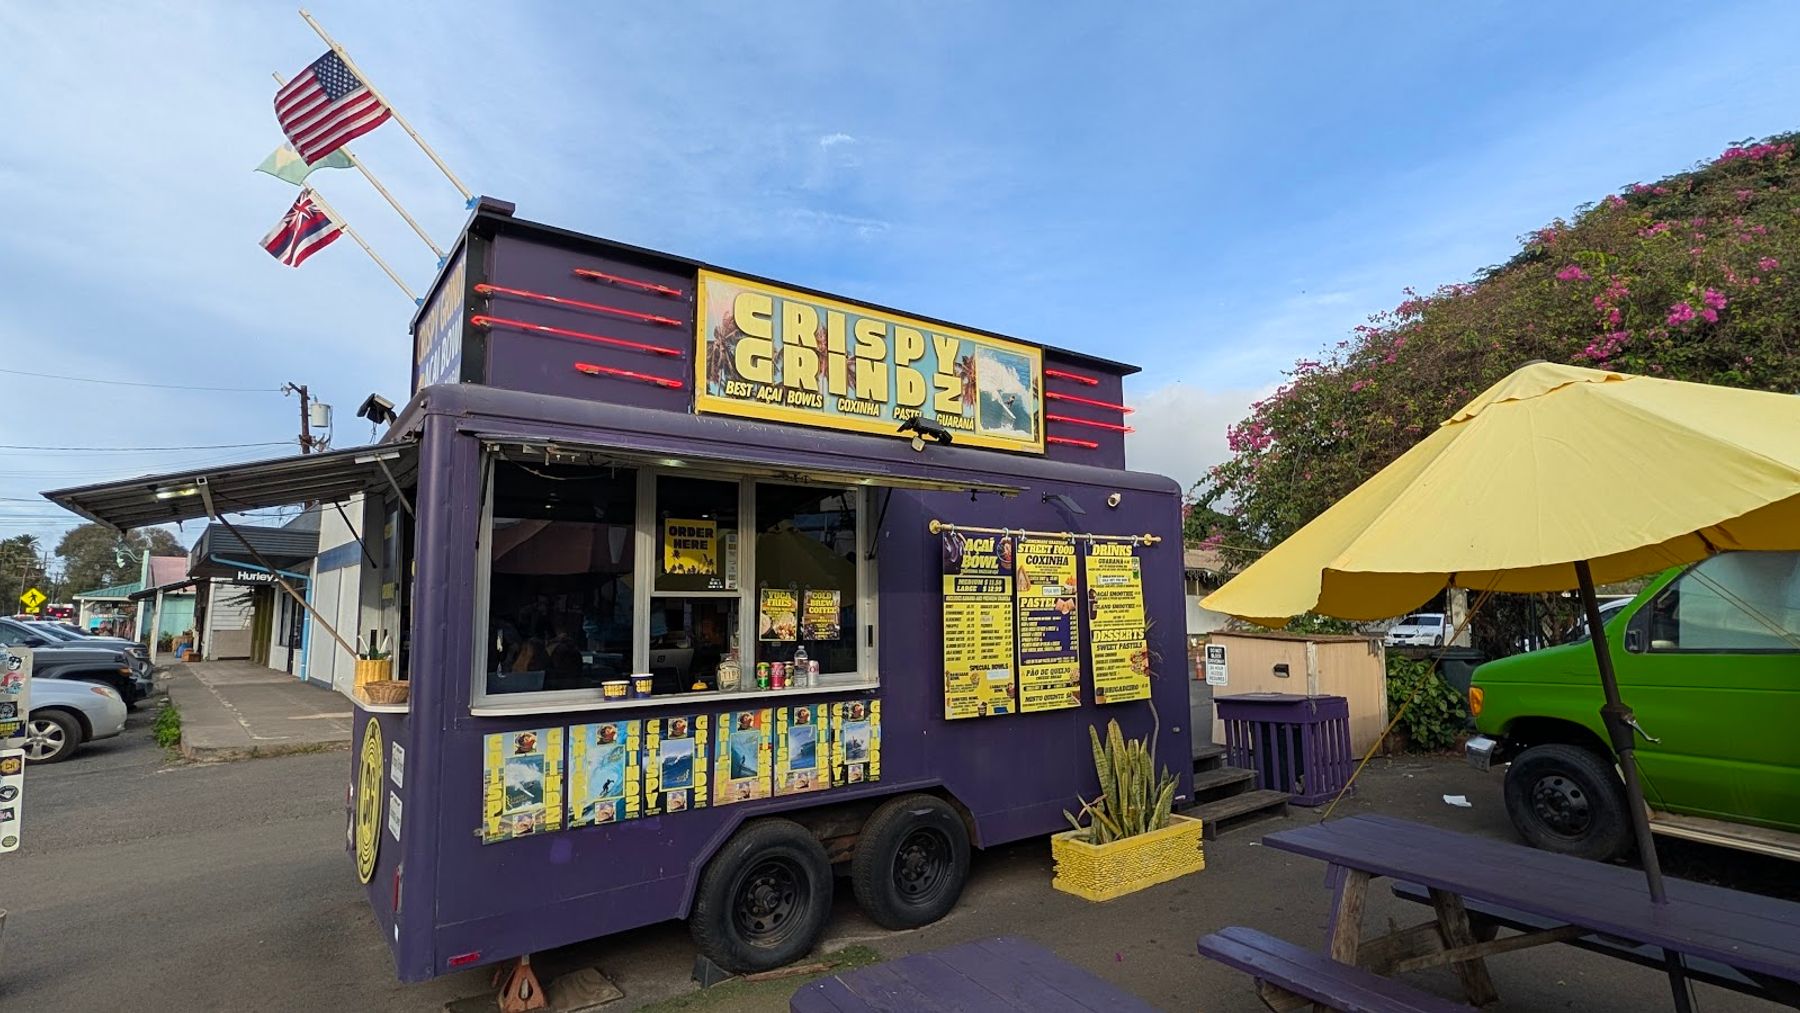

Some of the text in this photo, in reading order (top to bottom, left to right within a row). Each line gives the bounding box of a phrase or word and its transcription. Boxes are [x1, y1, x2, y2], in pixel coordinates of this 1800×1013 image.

[734, 292, 960, 374] CRISPY
[735, 337, 963, 413] GRINDZ
[725, 380, 752, 399] BEST
[756, 387, 783, 405] AÇAI
[787, 391, 823, 408] BOWLS
[837, 398, 880, 417] COXINHA
[936, 413, 974, 431] GUARANÁ
[669, 525, 714, 538] ORDER
[673, 539, 708, 550] HERE
[964, 537, 995, 554] AÇAÍ
[1018, 543, 1075, 554] STREET FOOD
[1092, 544, 1133, 556] DRINKS
[961, 554, 999, 569] BOWL
[1026, 555, 1069, 565] COXINHA
[237, 571, 275, 582] Hurley
[957, 578, 983, 586] MEDIUM
[767, 598, 792, 607] FRIES
[768, 591, 791, 599] YUCA
[812, 592, 832, 600] COLD
[1020, 597, 1056, 608] PASTEL
[808, 606, 837, 614] COFFEE
[810, 599, 833, 607] BREW
[1093, 628, 1145, 641] DESSERTS
[1118, 642, 1143, 650] PASTELS
[1040, 668, 1049, 676] DE
[817, 703, 828, 783] GRINDZ
[832, 703, 843, 780] CRISPY
[869, 700, 880, 775] GRINDZ
[717, 713, 730, 797] CRISPY
[759, 708, 773, 793] GRINDZ
[776, 707, 788, 789] CRISPY
[646, 719, 660, 808] CRISPY
[694, 715, 708, 802] GRINDZ
[573, 725, 587, 820] CRISPY
[625, 722, 640, 812] GRINDZ
[545, 727, 562, 823] GRINDZ
[487, 735, 503, 834] CRISPY
